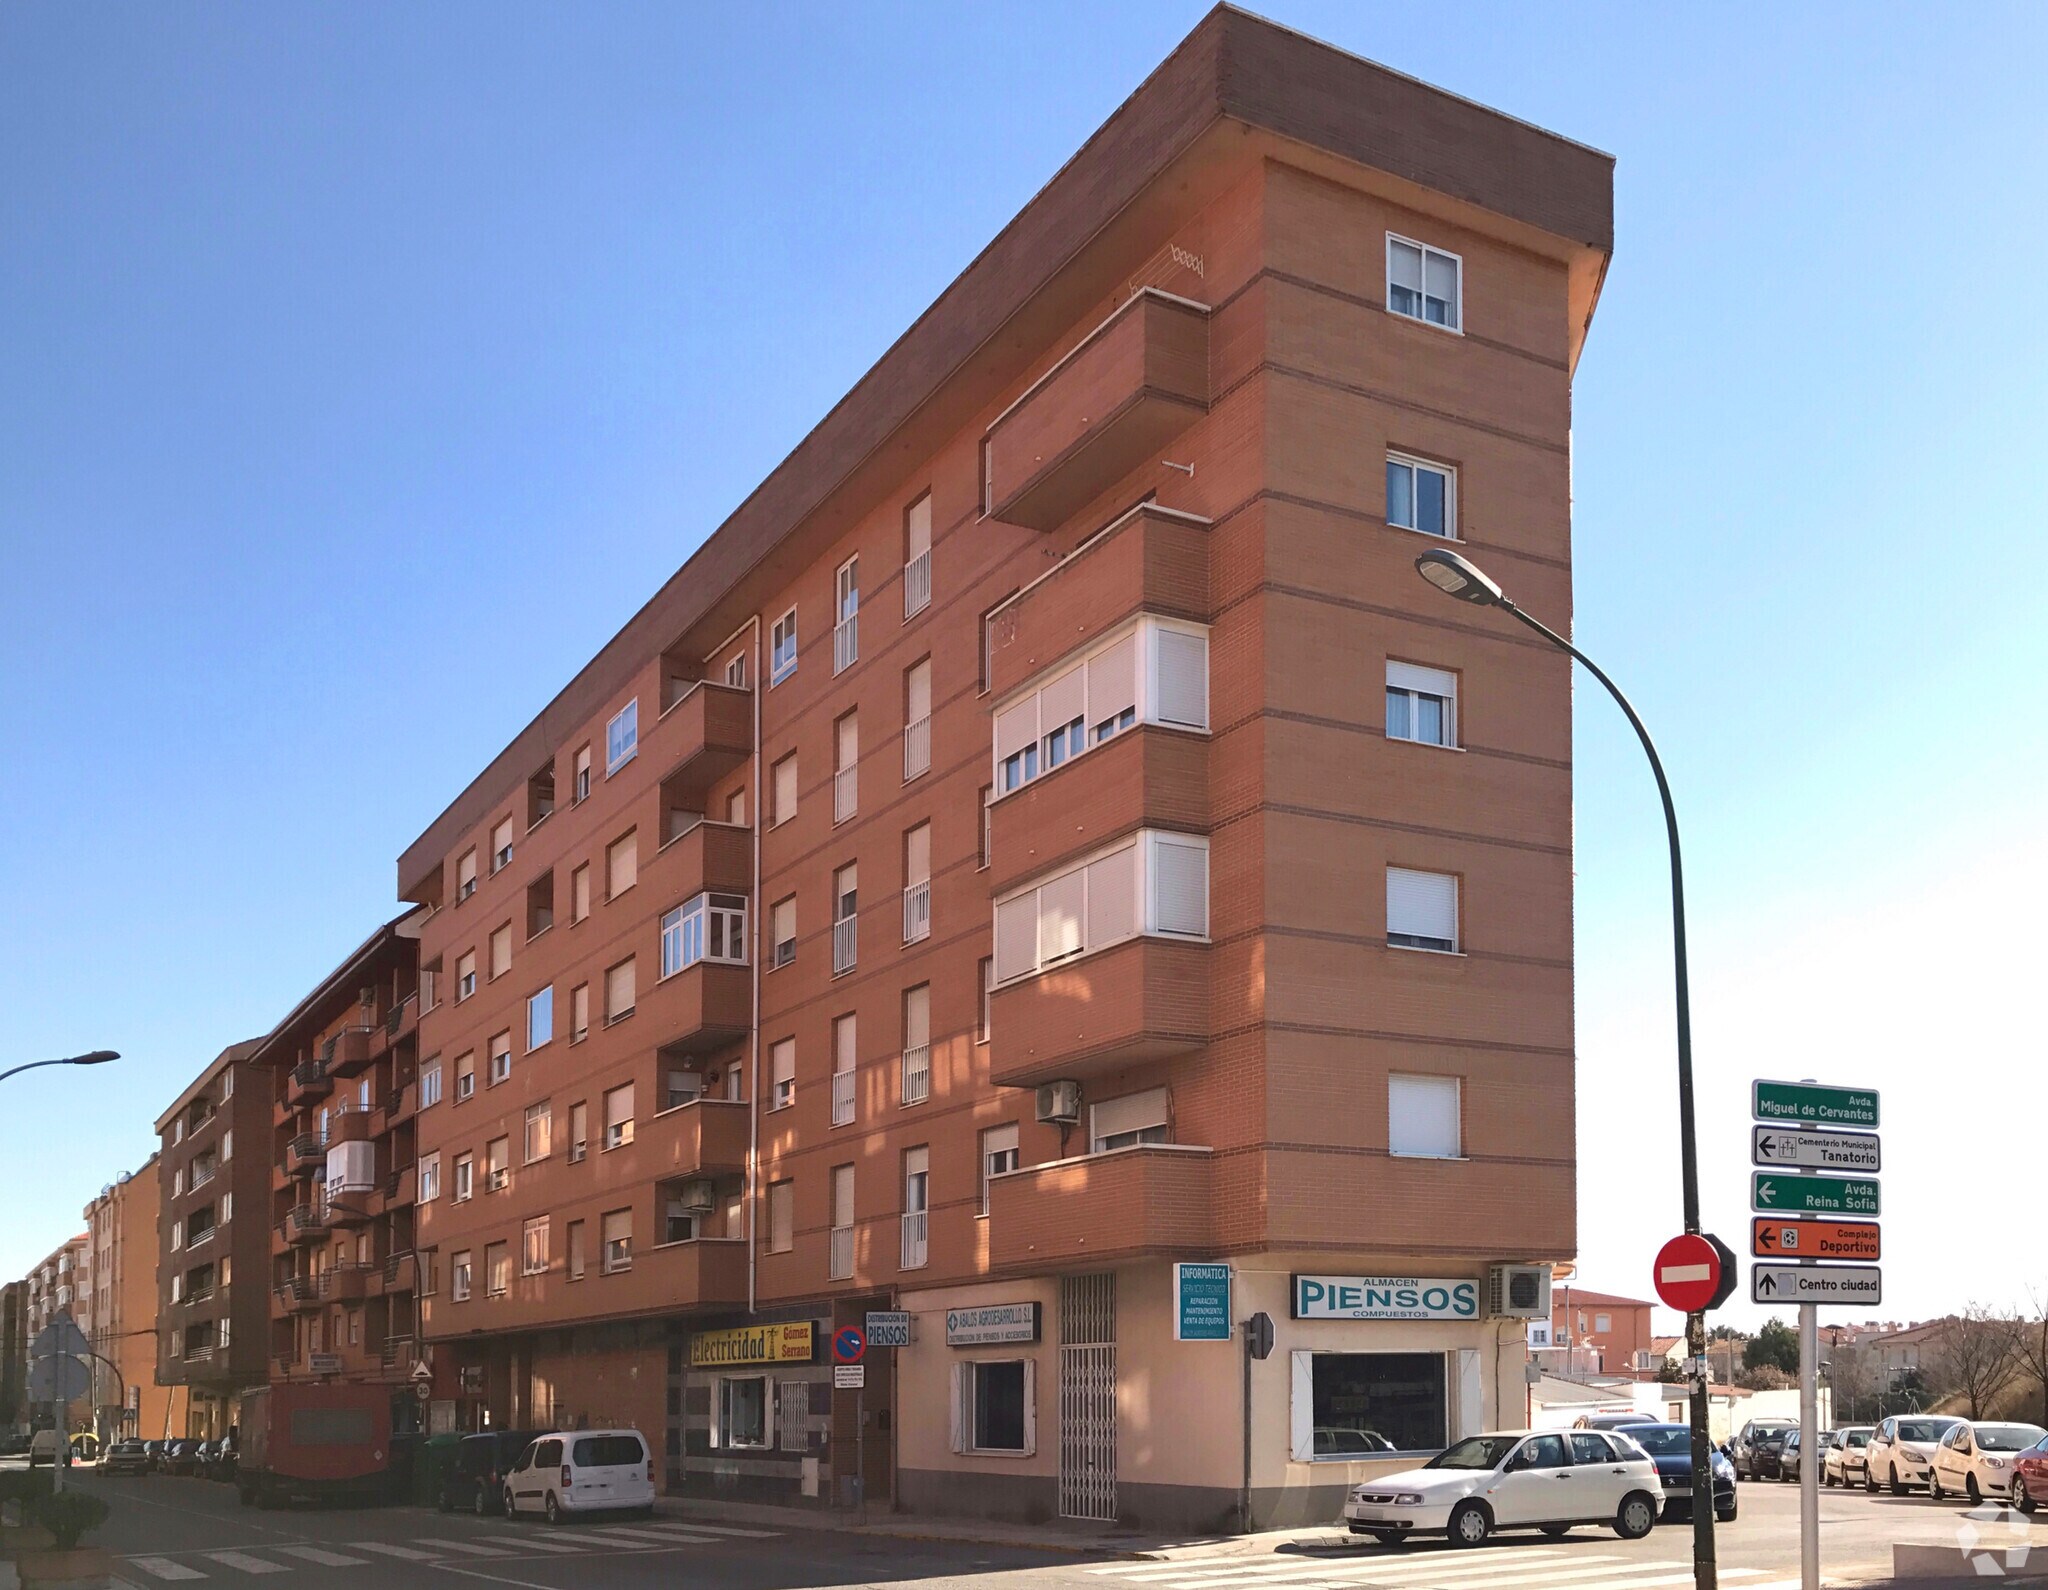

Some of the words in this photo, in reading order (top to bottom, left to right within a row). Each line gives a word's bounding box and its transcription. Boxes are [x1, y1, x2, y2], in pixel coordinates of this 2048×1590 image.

[1849, 1095, 1874, 1107] Avda.
[1760, 1100, 1798, 1116] Miguel
[1801, 1105, 1815, 1116] de
[1818, 1105, 1874, 1121] Cervantes
[1798, 1137, 1840, 1148] Cementerio
[1841, 1140, 1876, 1151] Municipal
[1820, 1150, 1876, 1164] Tanatorio
[1844, 1183, 1876, 1196] Avda.
[1806, 1195, 1839, 1208] Reina
[1837, 1229, 1876, 1240] Complejo
[1820, 1239, 1877, 1254] Deportivo
[1181, 1267, 1227, 1280] INFORMATICA
[1363, 1278, 1419, 1287] ALMACEN
[1799, 1278, 1838, 1291] Centro
[1840, 1278, 1878, 1292] ciudad
[1301, 1279, 1476, 1316] PIENSOS
[1352, 1310, 1429, 1318] COMPUESTOS
[783, 1325, 809, 1341] Gómez
[868, 1326, 907, 1345] PIENSOS
[692, 1329, 765, 1362] Electricidad
[781, 1344, 810, 1358] Serrano
